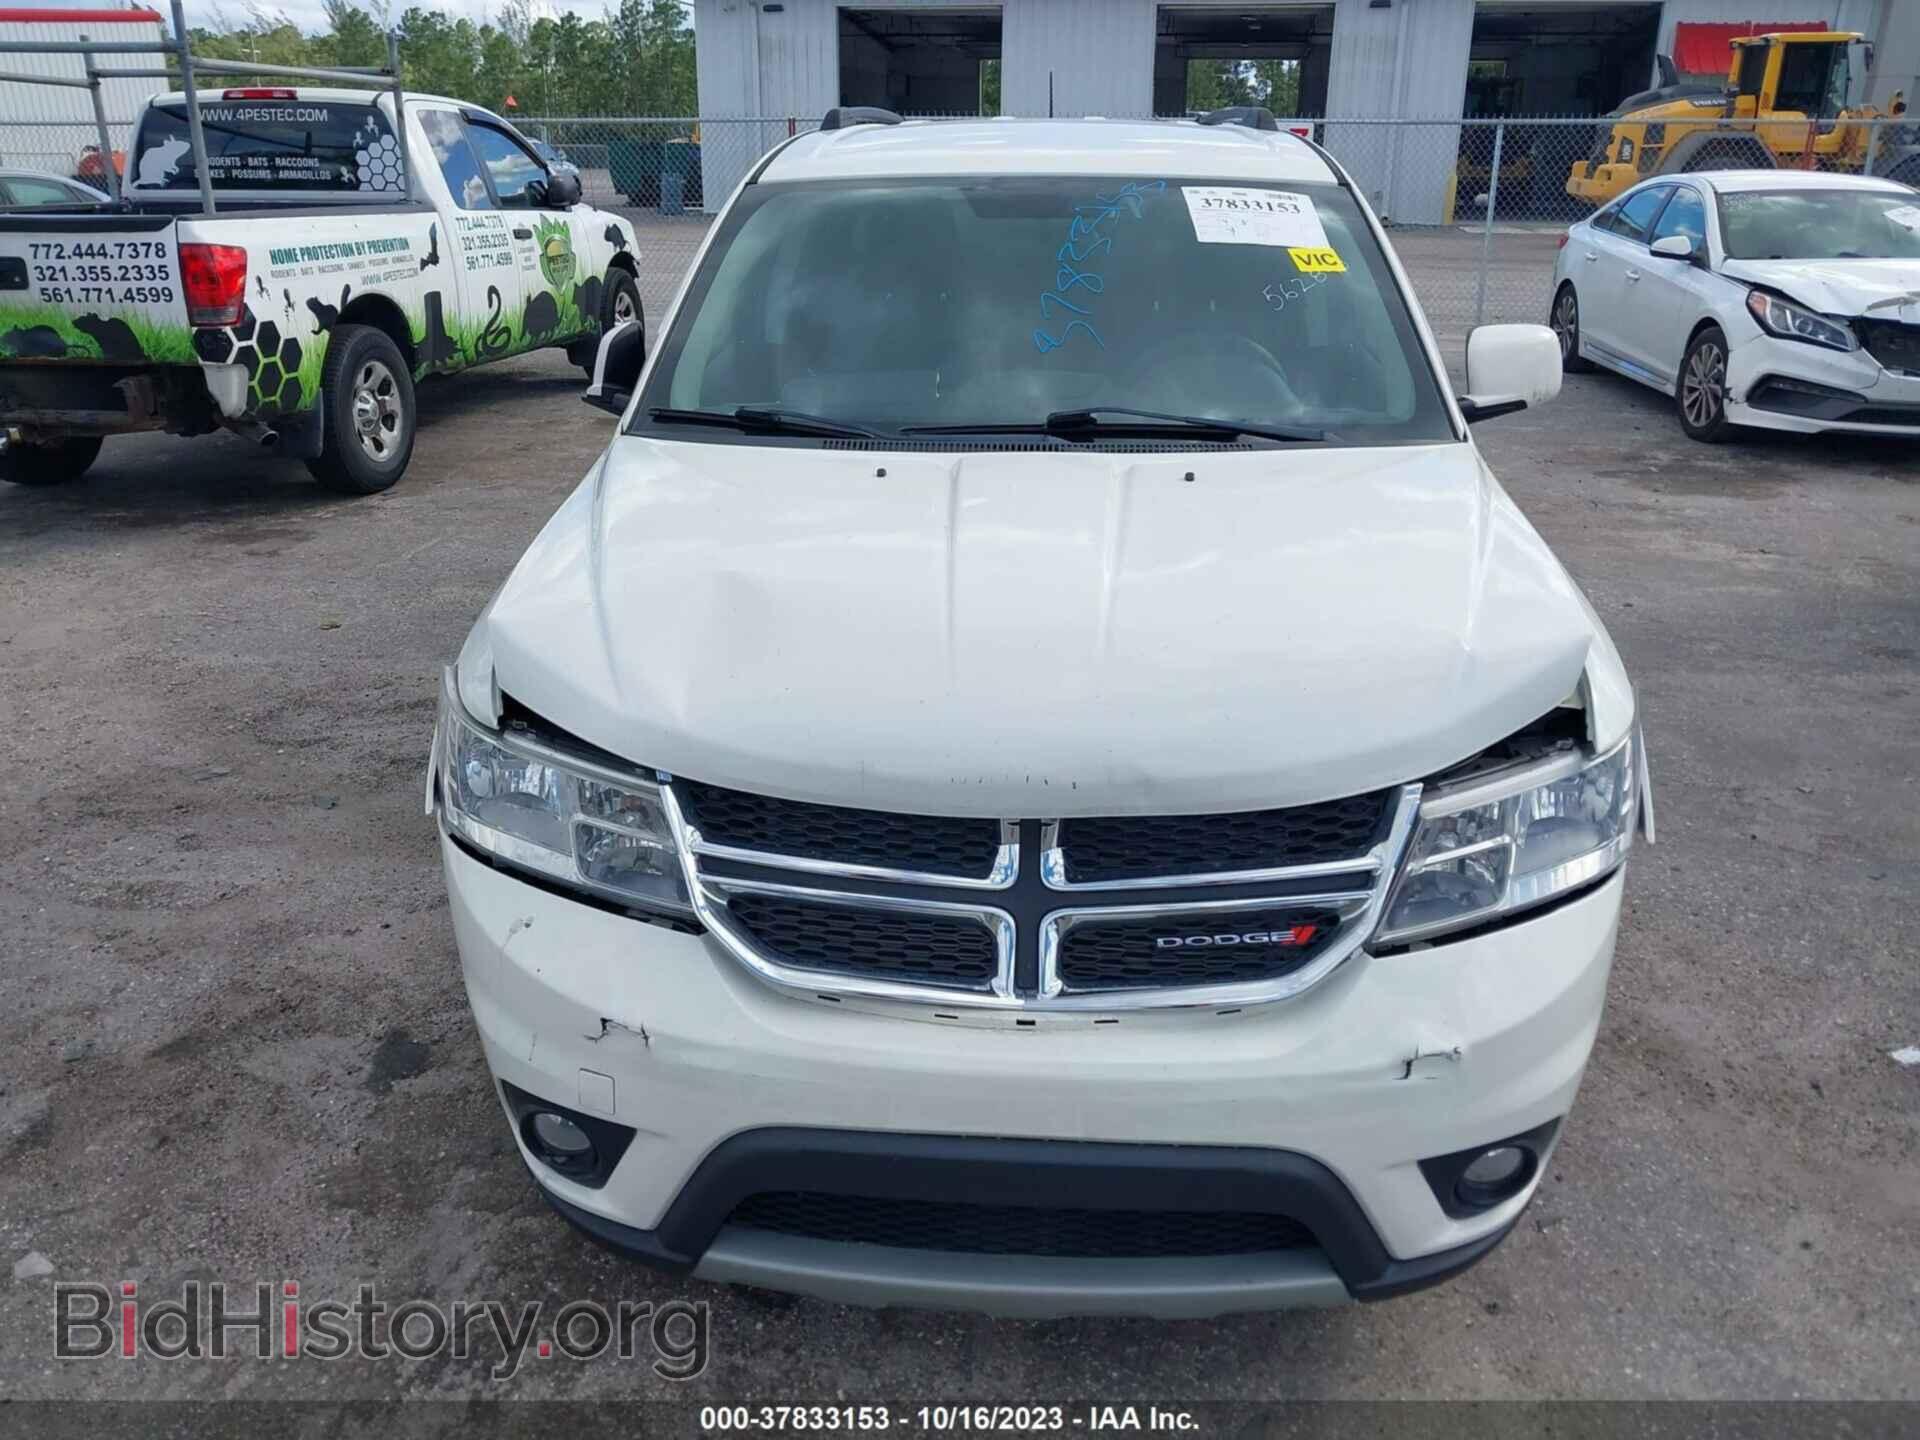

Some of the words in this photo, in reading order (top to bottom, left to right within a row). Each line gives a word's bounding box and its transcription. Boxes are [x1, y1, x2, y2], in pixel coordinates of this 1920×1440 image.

[208, 157, 241, 167] ODENTS
[248, 157, 268, 167] BATS
[275, 157, 320, 168] RACCOONS
[194, 169, 225, 178] SKES
[232, 169, 272, 179] POSSUMS
[278, 169, 332, 180] ARMADILLOS
[1201, 197, 1302, 215] 37833153
[455, 215, 504, 231] 772.444.7378
[29, 242, 167, 259] 772.444.7378
[461, 233, 510, 251] 321.355.2335
[269, 246, 300, 265] HOME
[300, 241, 355, 262] PROTECTION
[354, 240, 367, 256] BY
[366, 237, 410, 254] PREVENTION
[1295, 253, 1338, 266] VIC
[33, 264, 170, 282] 321.355.2335
[39, 286, 173, 303] 561.771.4599
[1156, 930, 1297, 949] DODGE
